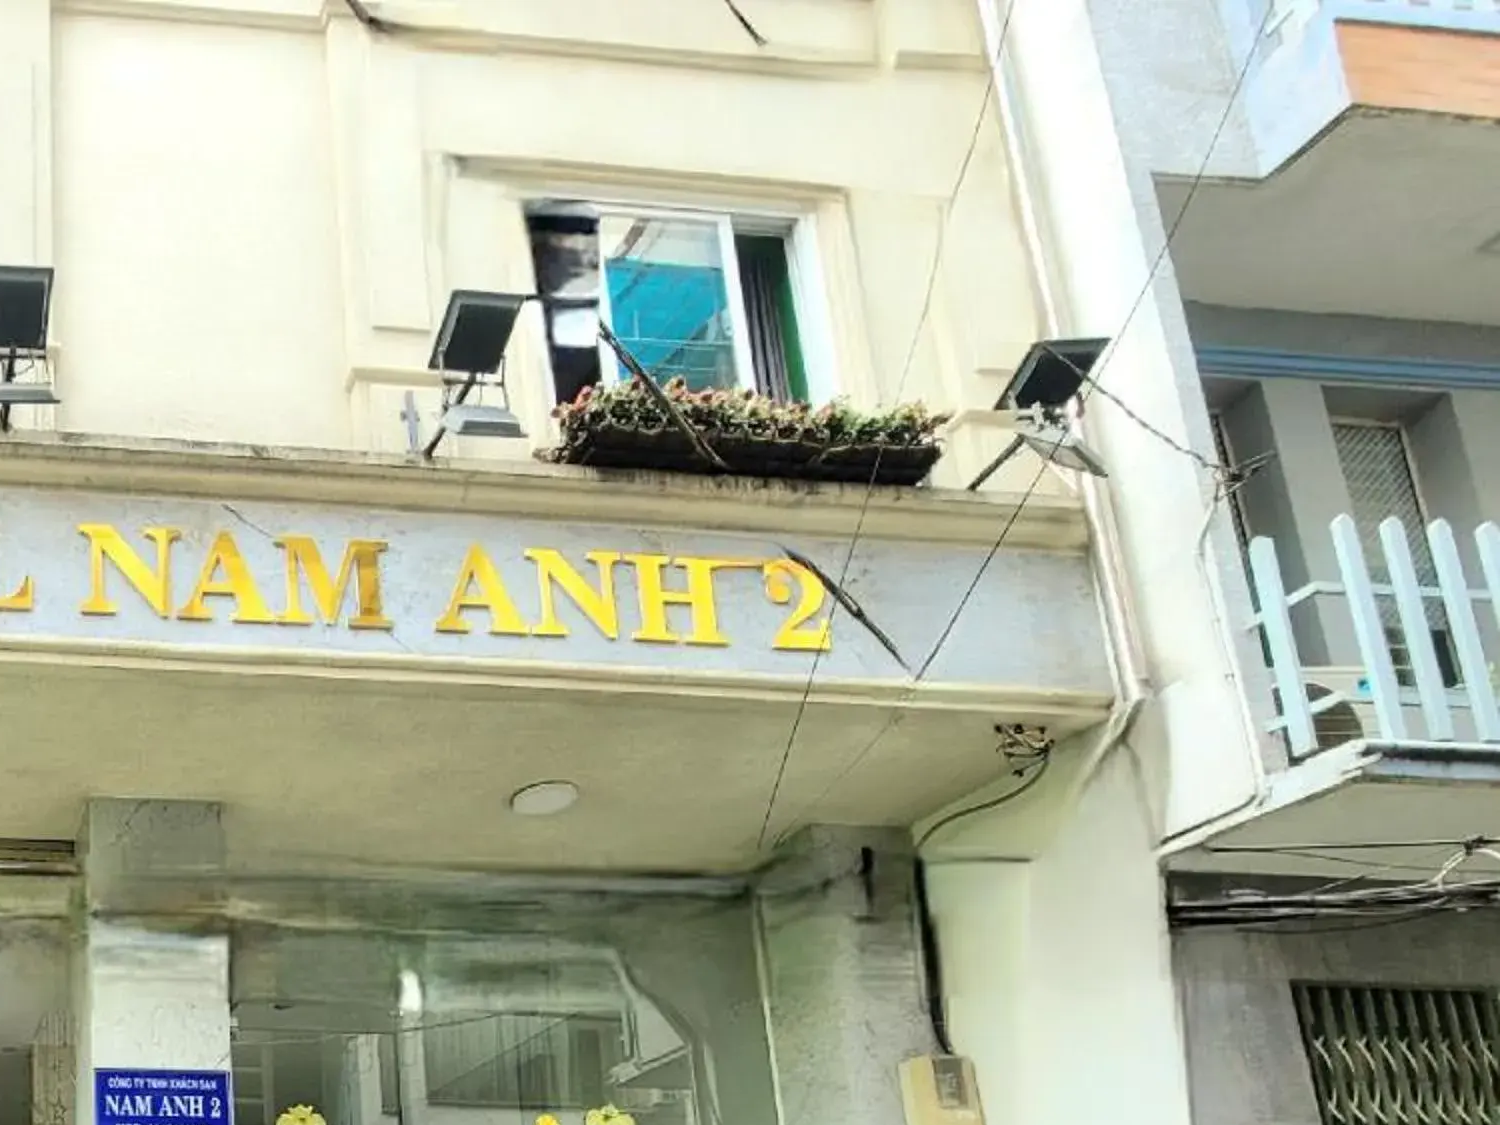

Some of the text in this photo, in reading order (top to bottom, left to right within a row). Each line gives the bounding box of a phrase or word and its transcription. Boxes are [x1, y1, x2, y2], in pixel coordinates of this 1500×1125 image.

[76, 522, 392, 630] NAM
[435, 542, 732, 648] ANH
[764, 552, 834, 652] 2
[105, 1095, 221, 1118] NAM ANH 2
